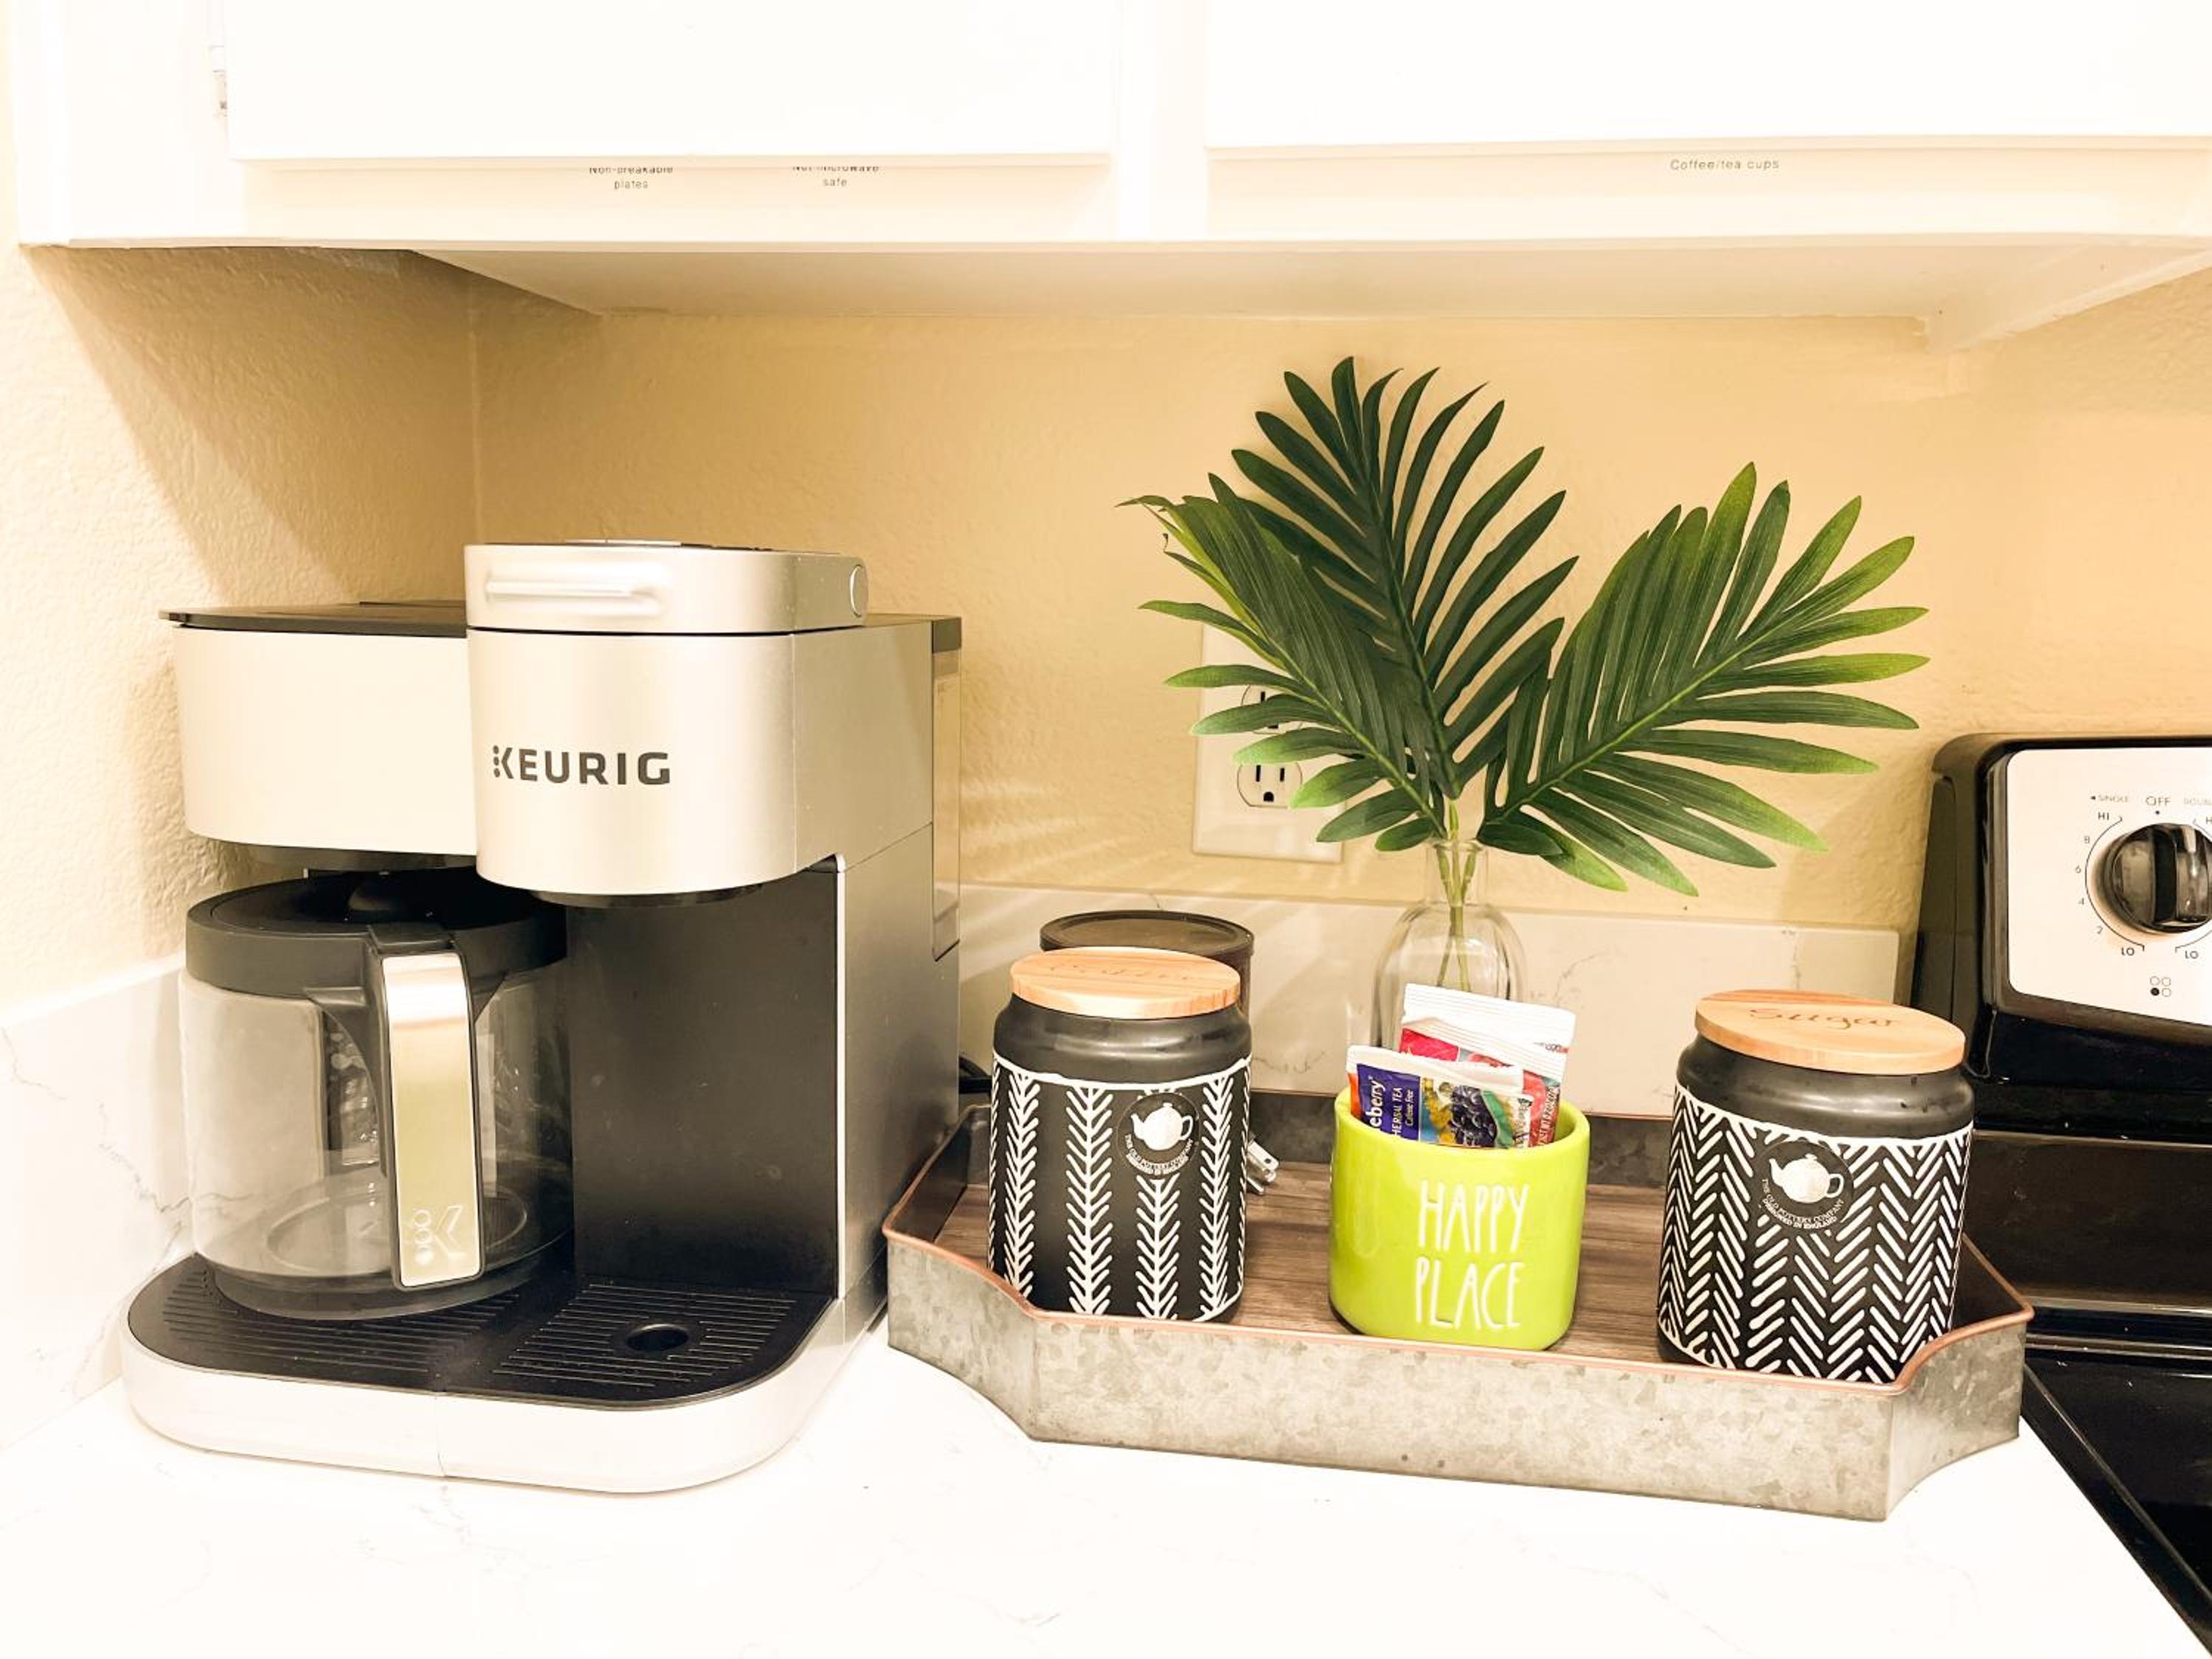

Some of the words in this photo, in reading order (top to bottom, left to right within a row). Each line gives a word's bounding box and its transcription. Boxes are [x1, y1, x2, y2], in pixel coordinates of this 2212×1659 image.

[1670, 159, 1742, 171] Coffee/tea
[1747, 159, 1780, 172] cups
[614, 180, 649, 189] plates
[823, 178, 849, 187] safe
[493, 745, 670, 785] KEURIG
[2145, 796, 2171, 807] OFF
[2098, 812, 2110, 821] HI
[2084, 835, 2091, 844] 8
[2075, 865, 2081, 874] 6
[2078, 897, 2085, 906] 4
[2096, 926, 2104, 935] 2
[1749, 1007, 1899, 1029] Sugar
[1392, 1087, 1402, 1102] TEA
[1418, 1179, 1529, 1253] HAPPY
[1415, 1256, 1525, 1329] PLACE
